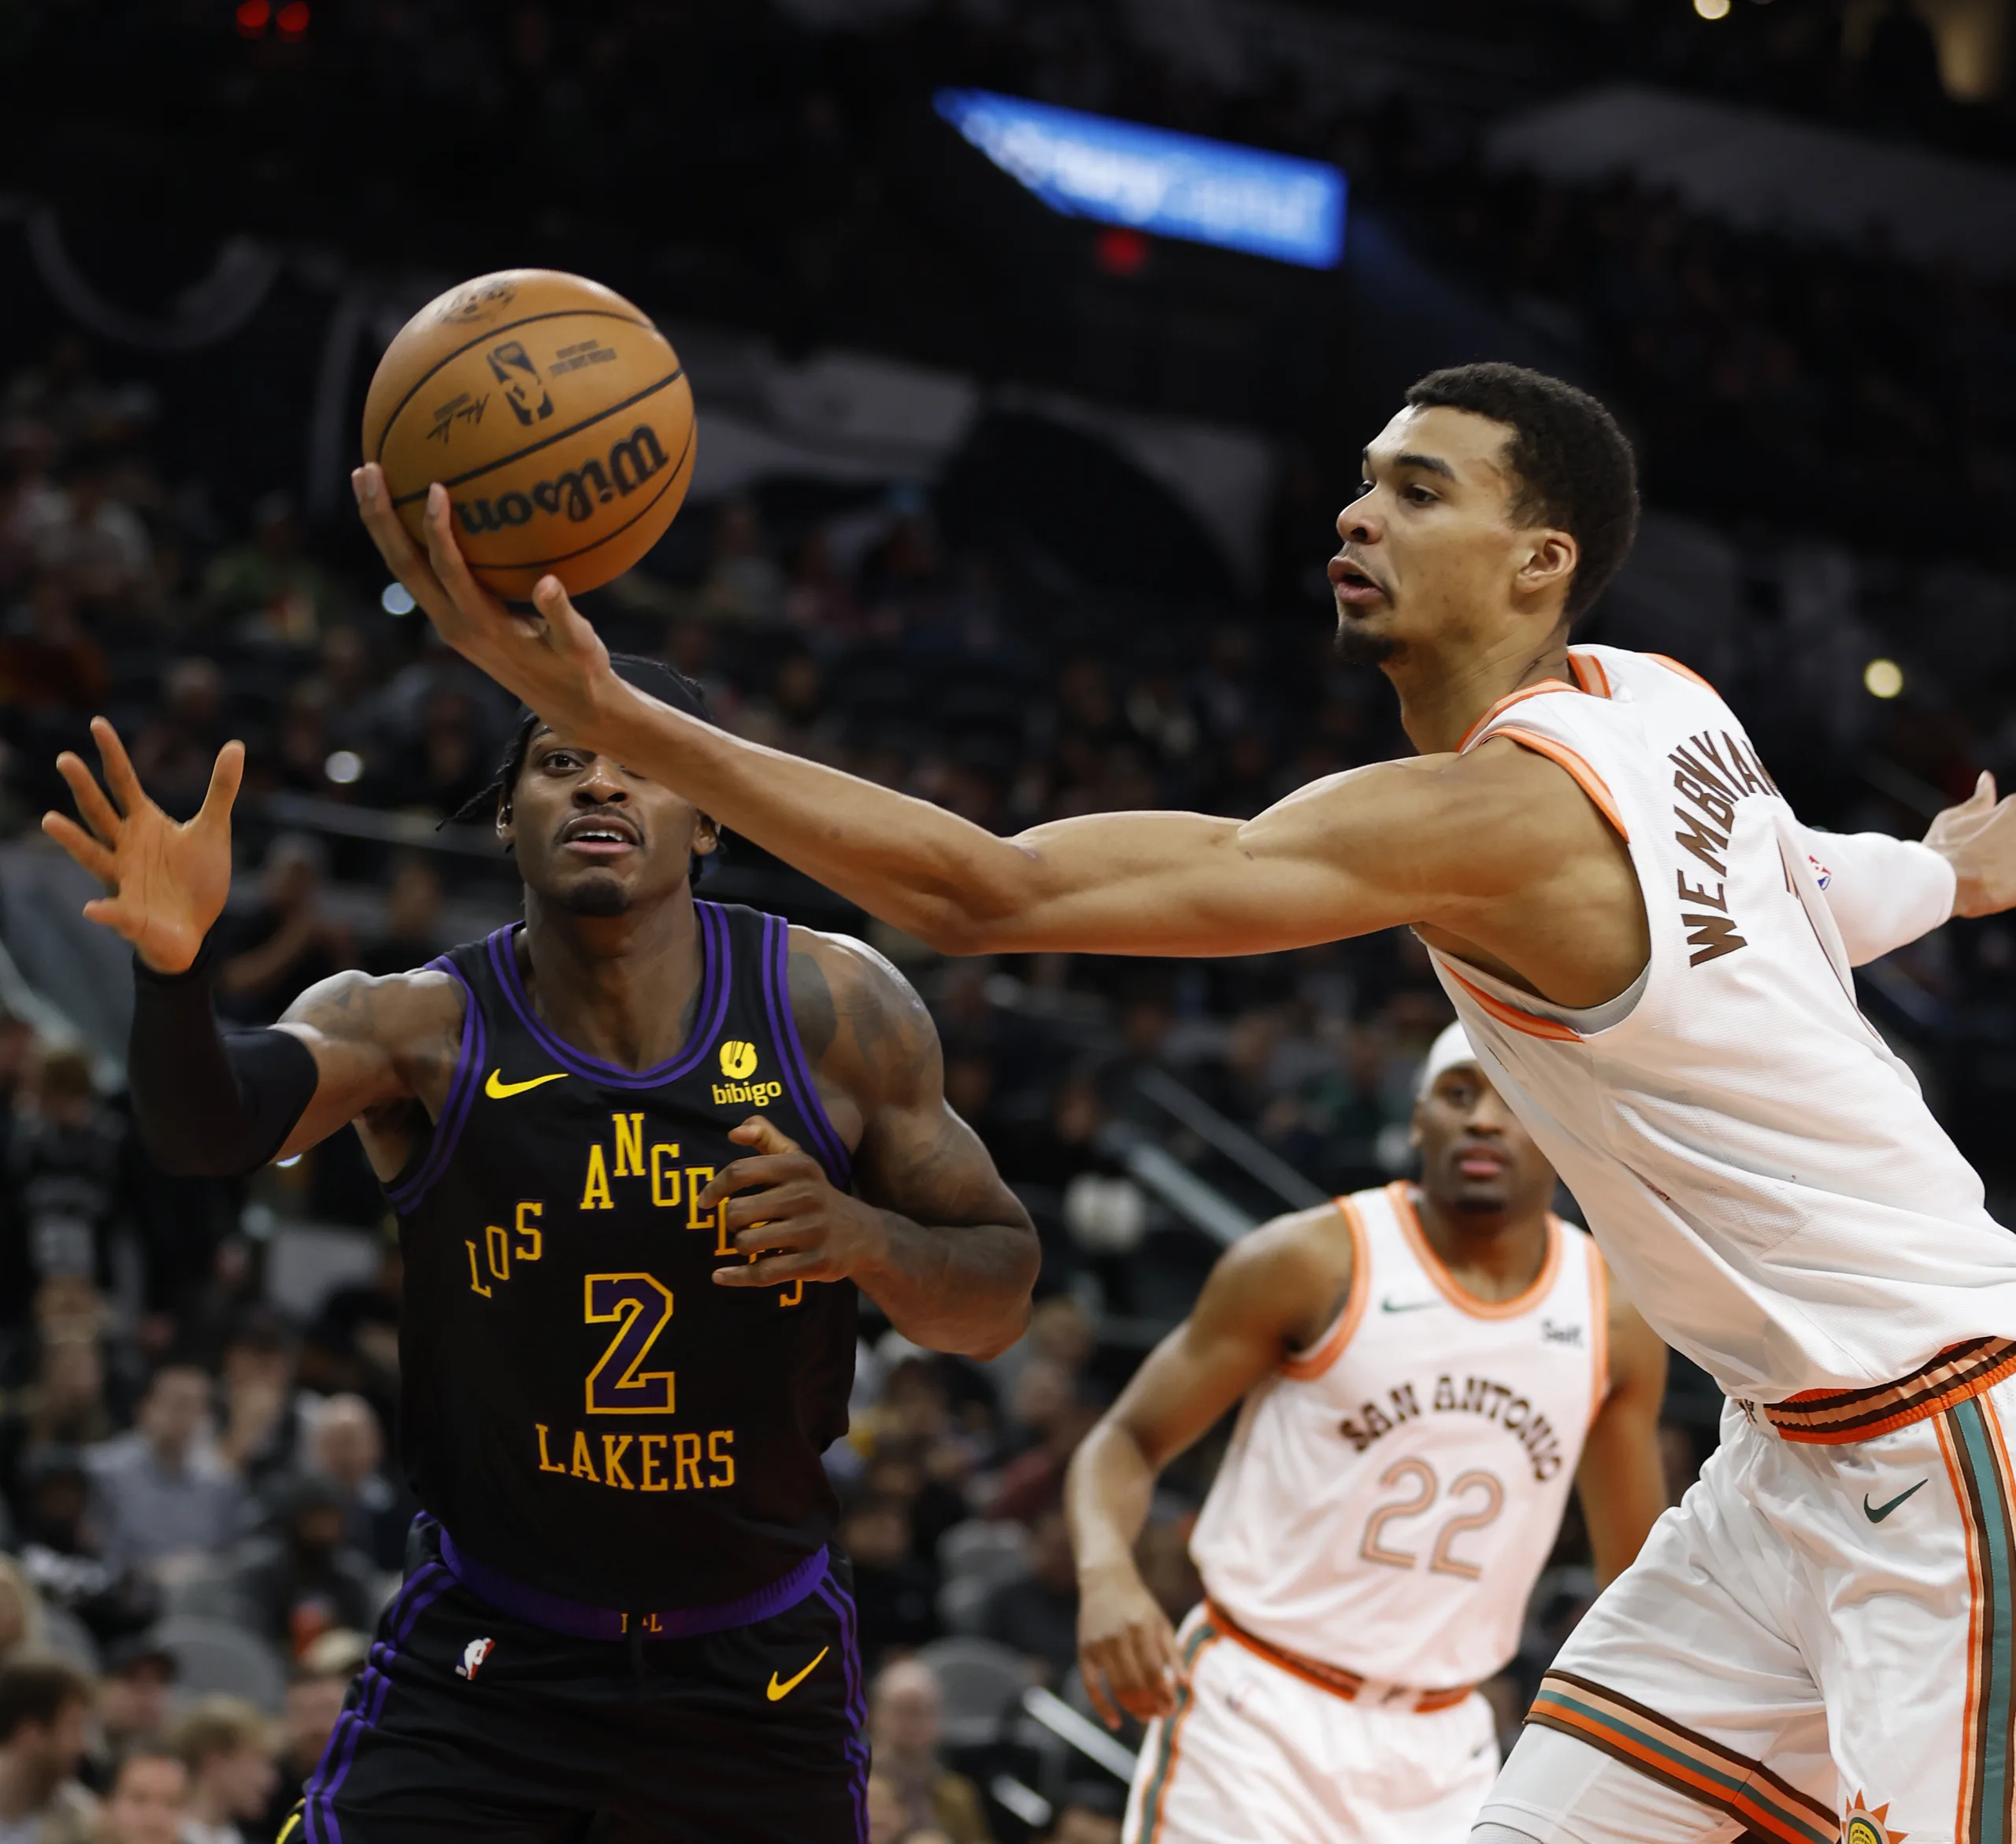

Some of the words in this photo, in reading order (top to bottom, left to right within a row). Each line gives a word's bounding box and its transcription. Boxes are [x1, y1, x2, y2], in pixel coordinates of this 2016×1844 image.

[454, 424, 669, 535] Wilson
[712, 1079, 782, 1106] bibigo
[465, 1202, 543, 1298] LOS
[585, 1272, 676, 1415] 2
[536, 1424, 736, 1491] LAKERS
[1338, 1381, 1421, 1453] SAN
[1432, 1373, 1562, 1483] ANTONIO
[1359, 1456, 1504, 1582] 22
